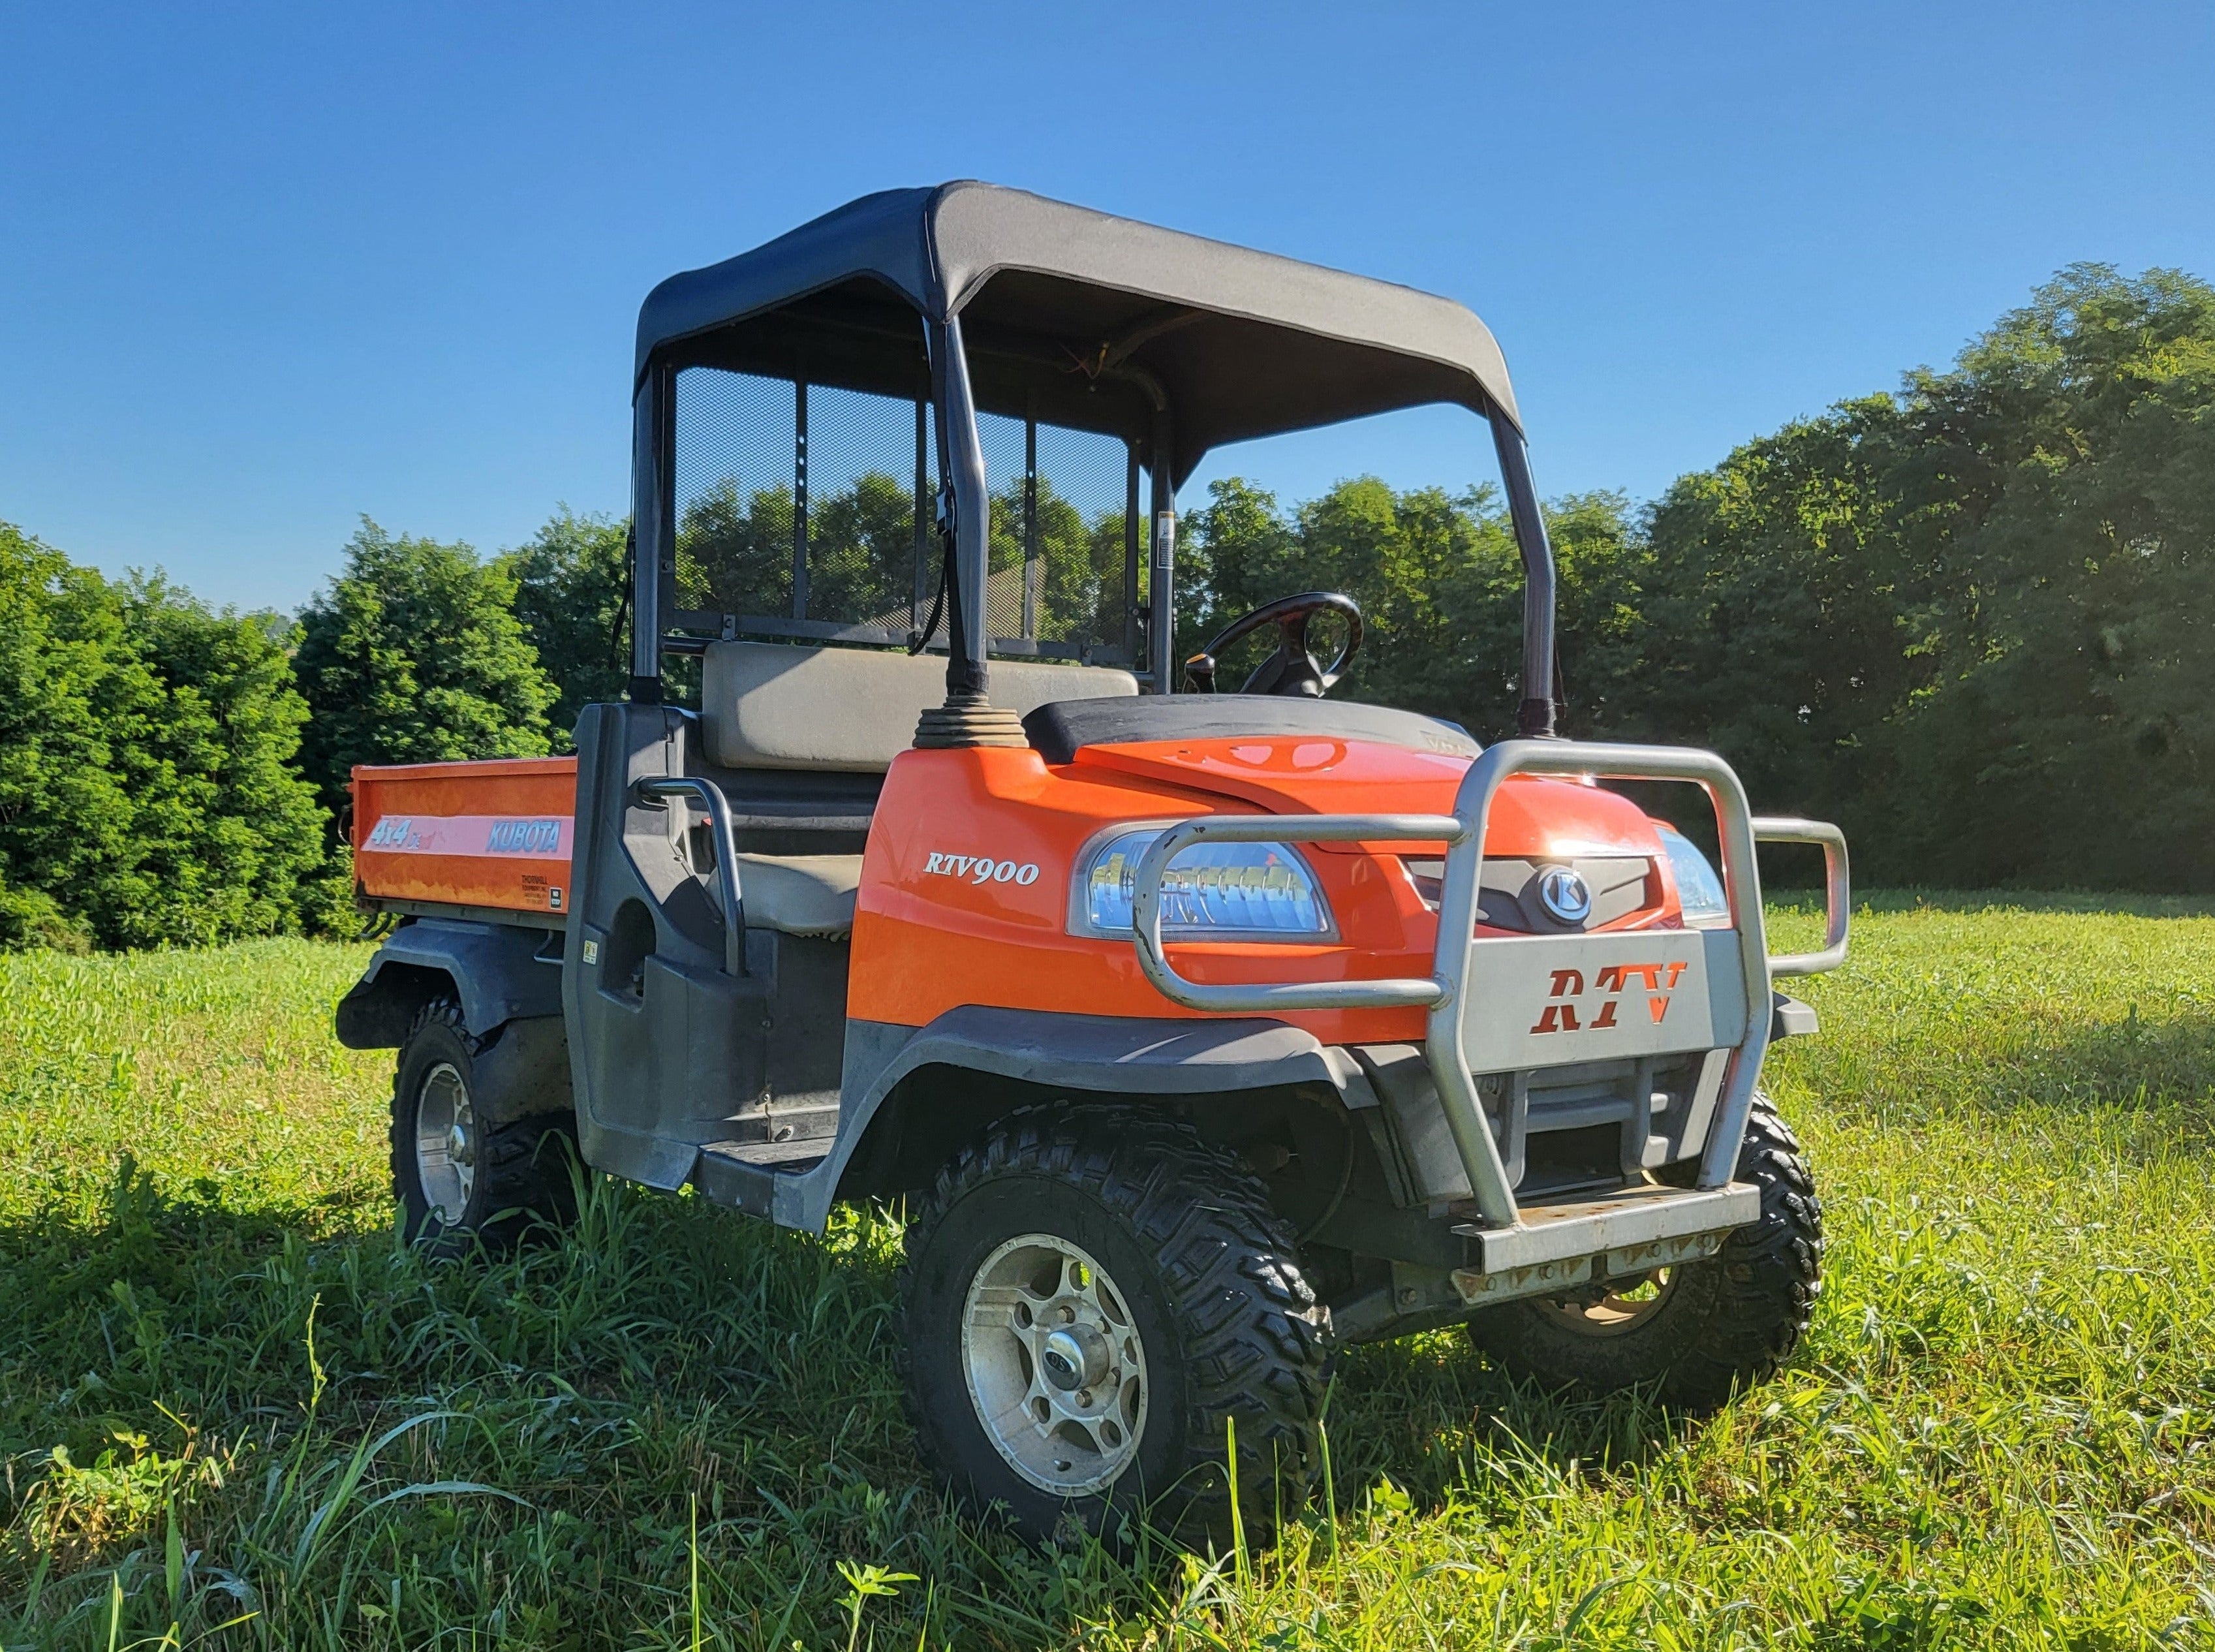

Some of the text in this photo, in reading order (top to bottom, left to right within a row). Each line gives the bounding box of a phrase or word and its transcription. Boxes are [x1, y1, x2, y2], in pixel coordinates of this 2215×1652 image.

[371, 819, 411, 845] 4x4
[486, 820, 561, 852] KUBOTA
[923, 852, 1040, 885] RTV900
[1529, 961, 1688, 1035] RTV
